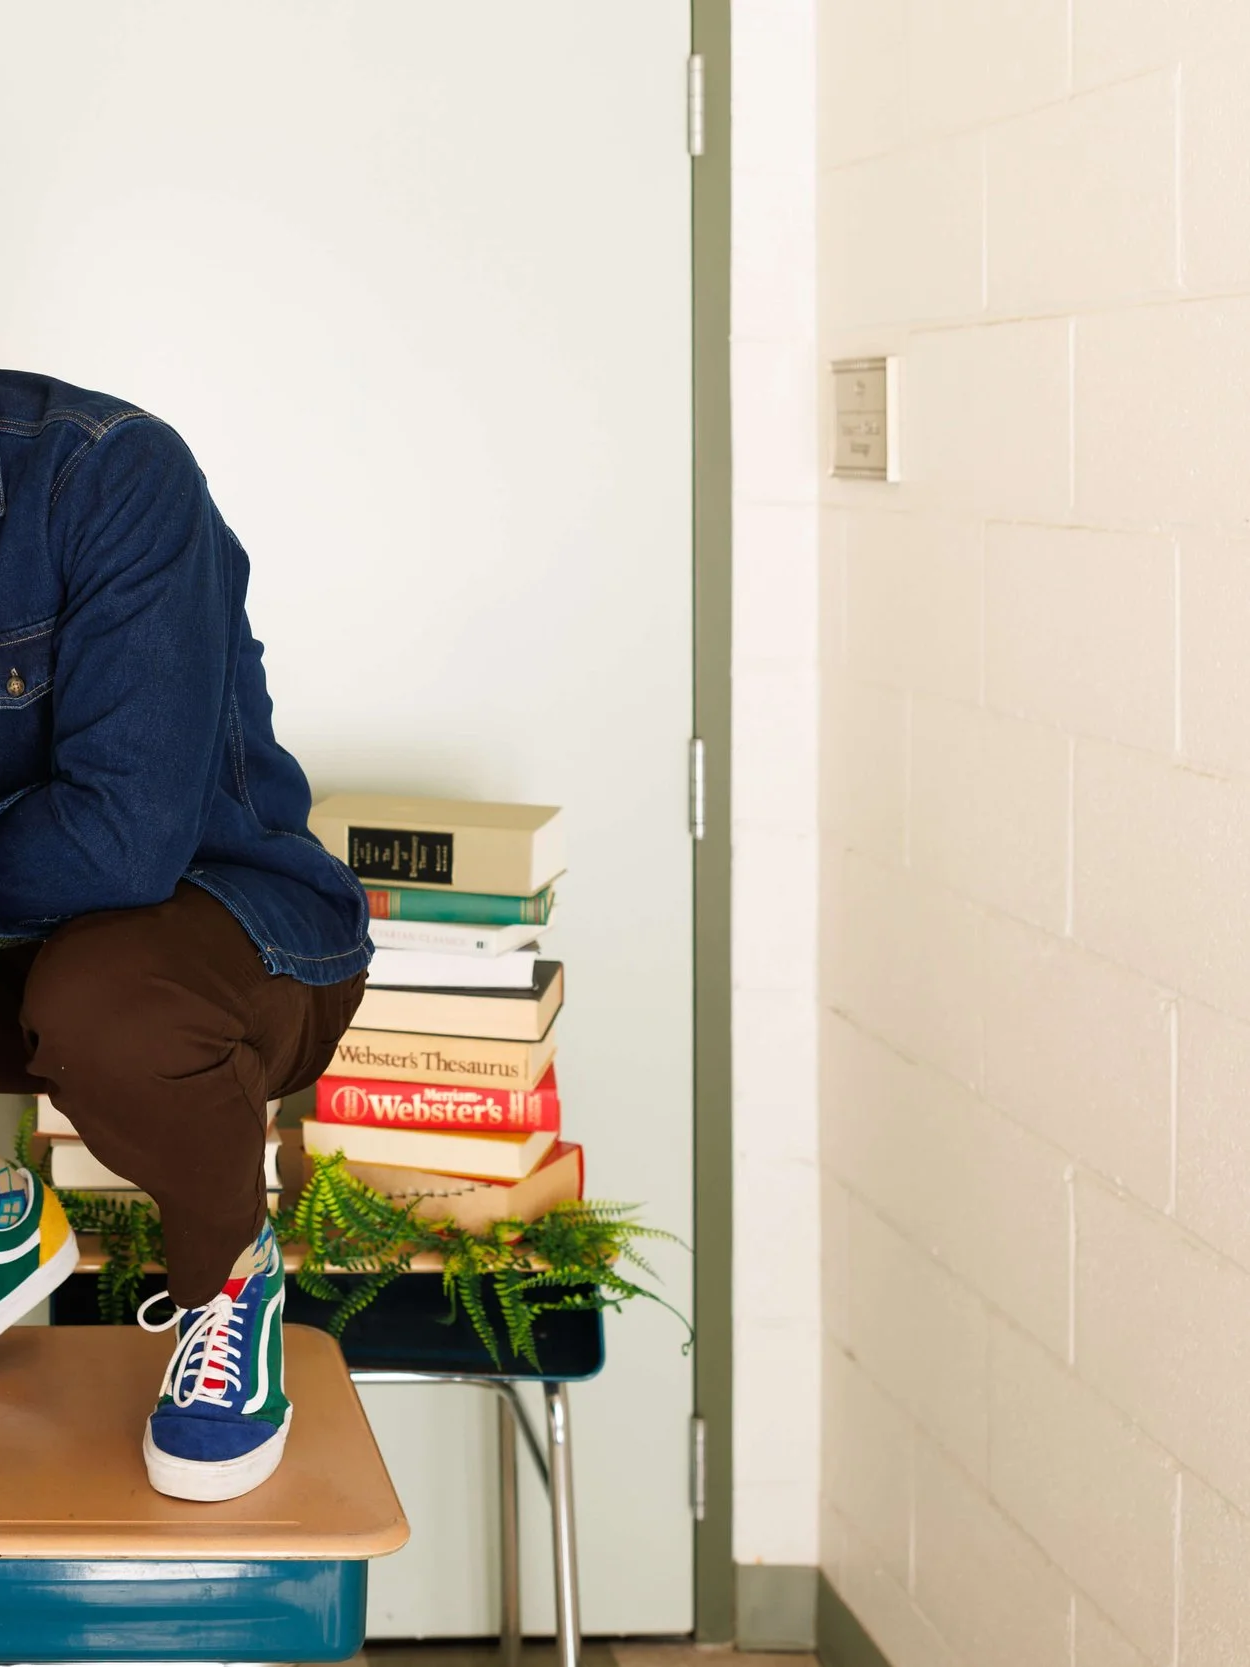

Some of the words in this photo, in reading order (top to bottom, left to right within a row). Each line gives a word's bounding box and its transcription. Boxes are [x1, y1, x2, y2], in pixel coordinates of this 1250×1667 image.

[338, 1044, 418, 1069] Webster's
[421, 1051, 519, 1078] Thesaurus
[368, 1094, 503, 1124] Webster's
